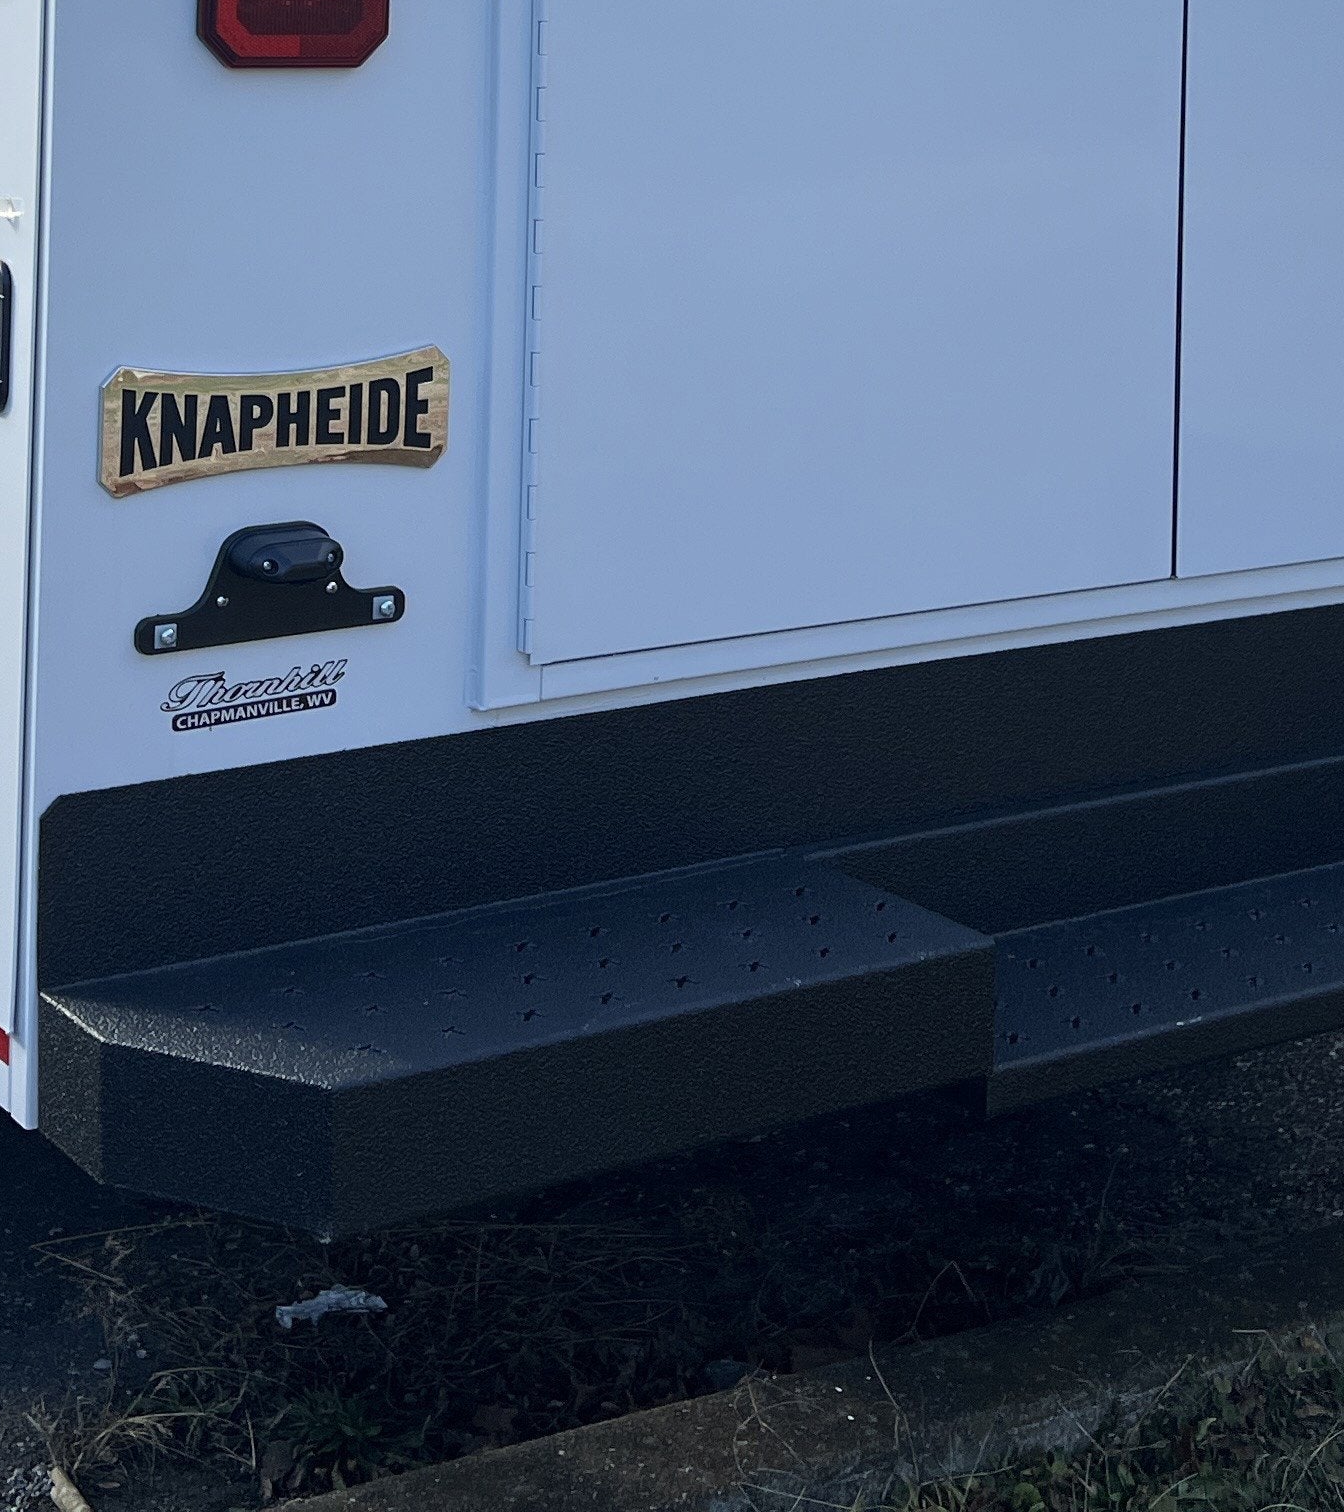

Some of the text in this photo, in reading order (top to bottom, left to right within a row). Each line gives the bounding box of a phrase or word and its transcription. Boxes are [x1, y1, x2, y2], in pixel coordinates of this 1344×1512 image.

[119, 365, 434, 478] KNAPHEIDE
[160, 658, 348, 712] Thornhill
[176, 691, 333, 730] CHAPMANVILLE, WV
